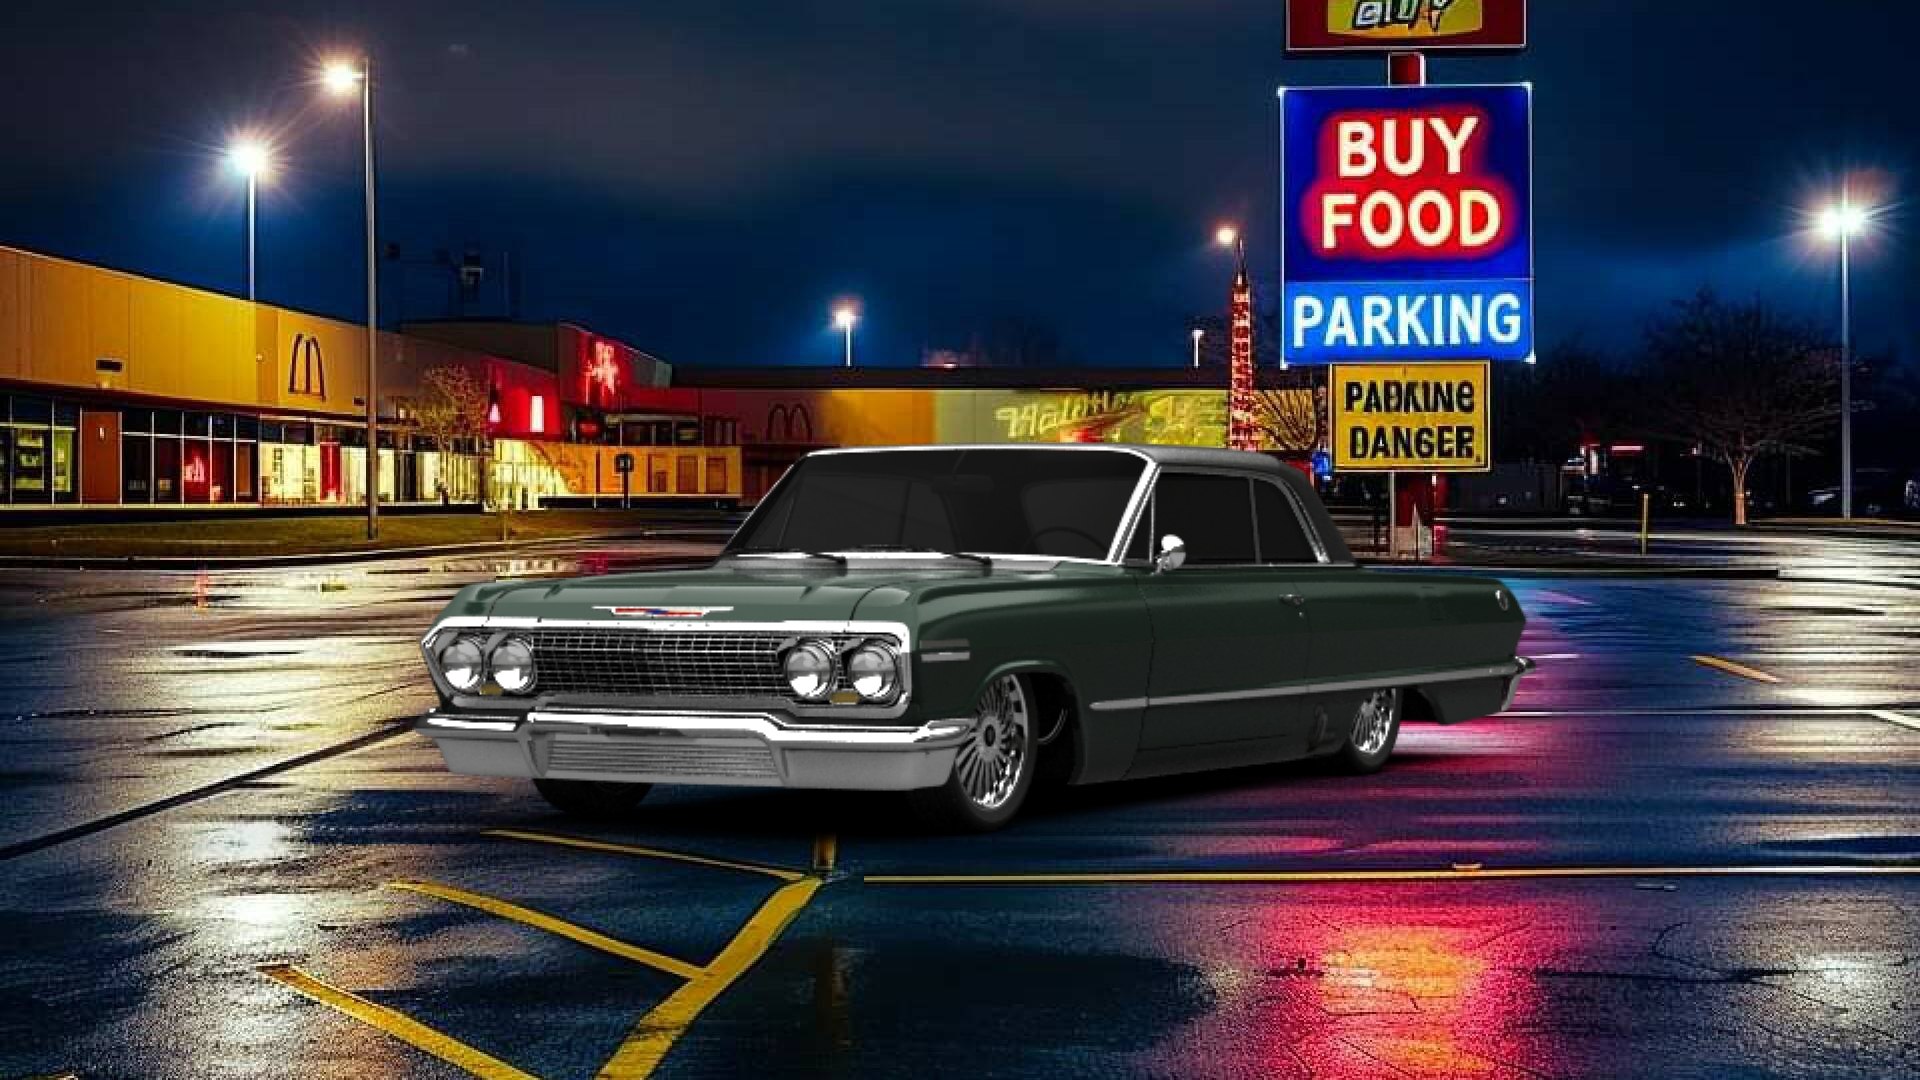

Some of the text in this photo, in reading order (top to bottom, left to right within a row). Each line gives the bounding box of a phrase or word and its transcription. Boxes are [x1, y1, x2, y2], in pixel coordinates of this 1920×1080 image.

[1337, 115, 1479, 177] BUY
[1321, 189, 1501, 249] FOOD
[1292, 293, 1522, 349] PARKING
[1349, 425, 1475, 459] DANGER
